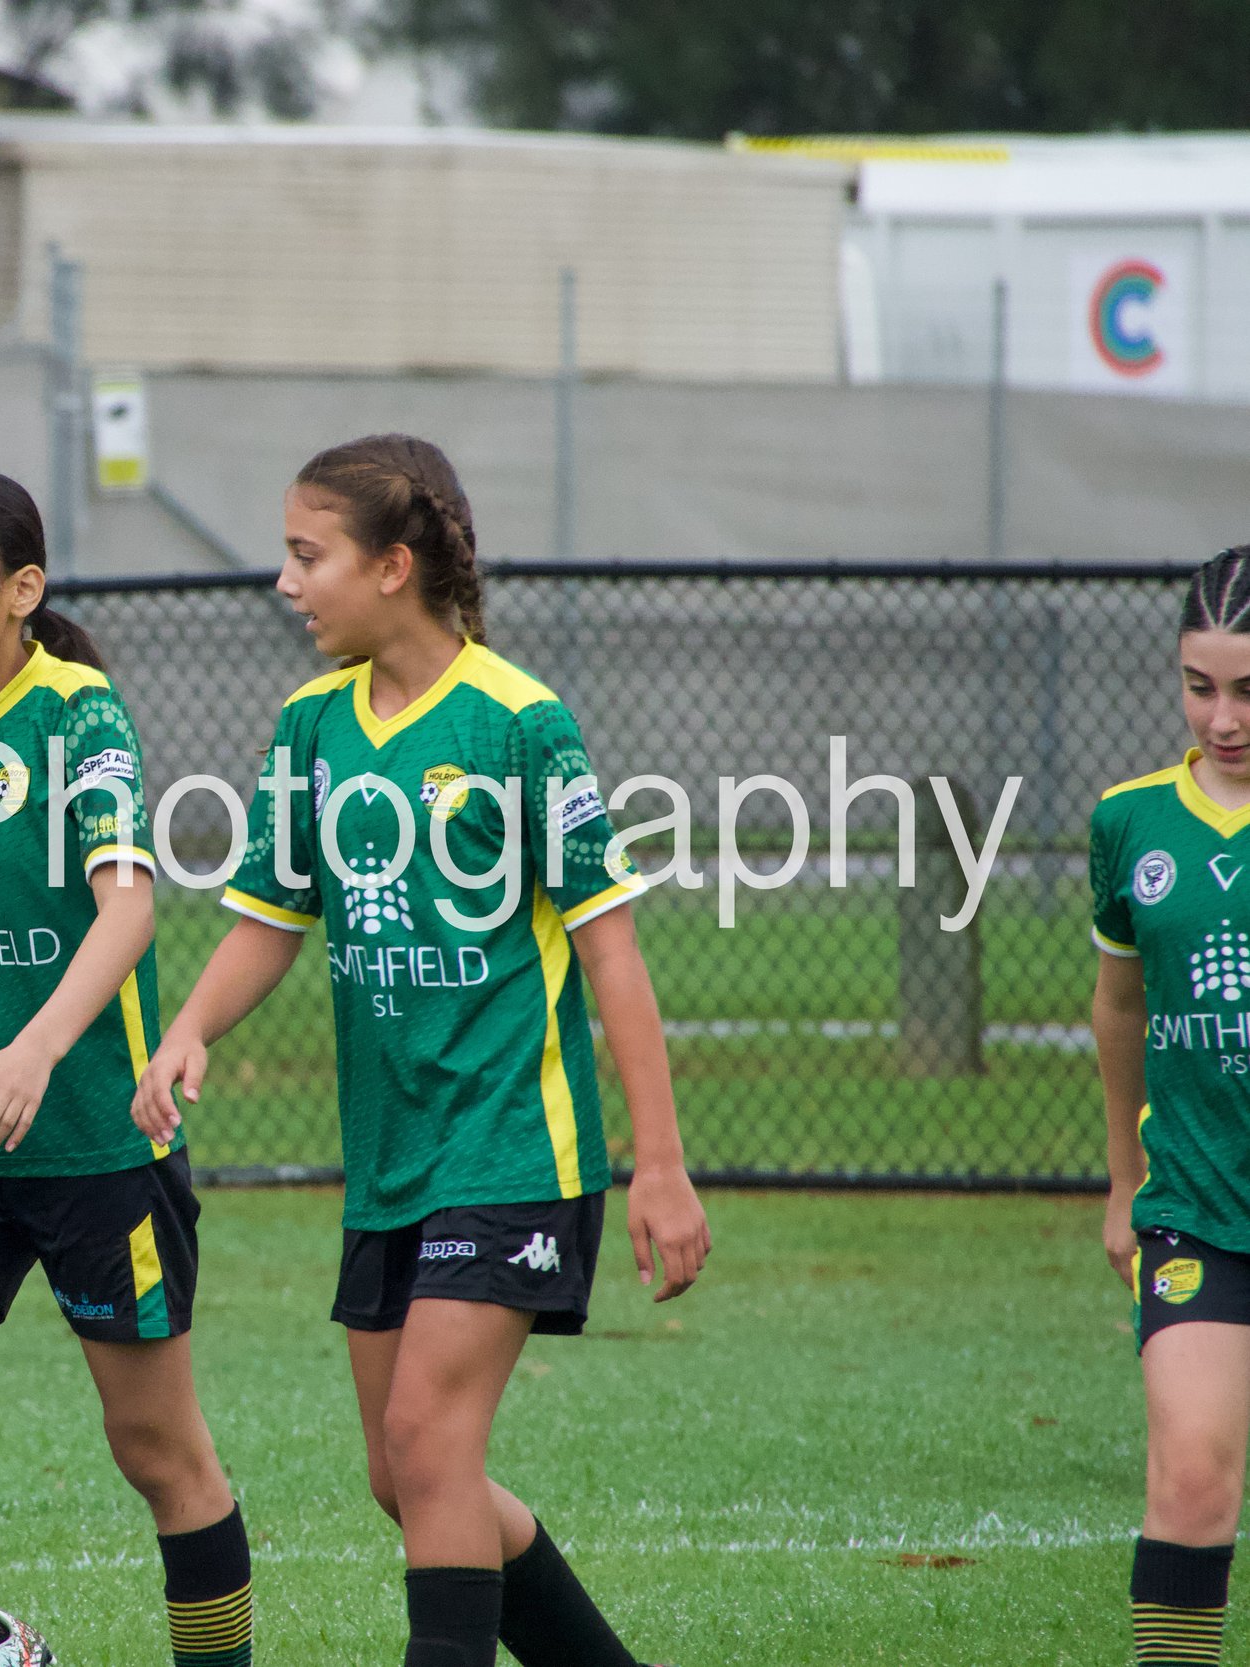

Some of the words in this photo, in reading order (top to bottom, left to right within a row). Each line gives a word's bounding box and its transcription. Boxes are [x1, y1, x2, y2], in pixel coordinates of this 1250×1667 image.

[371, 994, 403, 1017] SL
[1152, 1012, 1250, 1050] SMITH
[419, 1241, 476, 1260] appa
